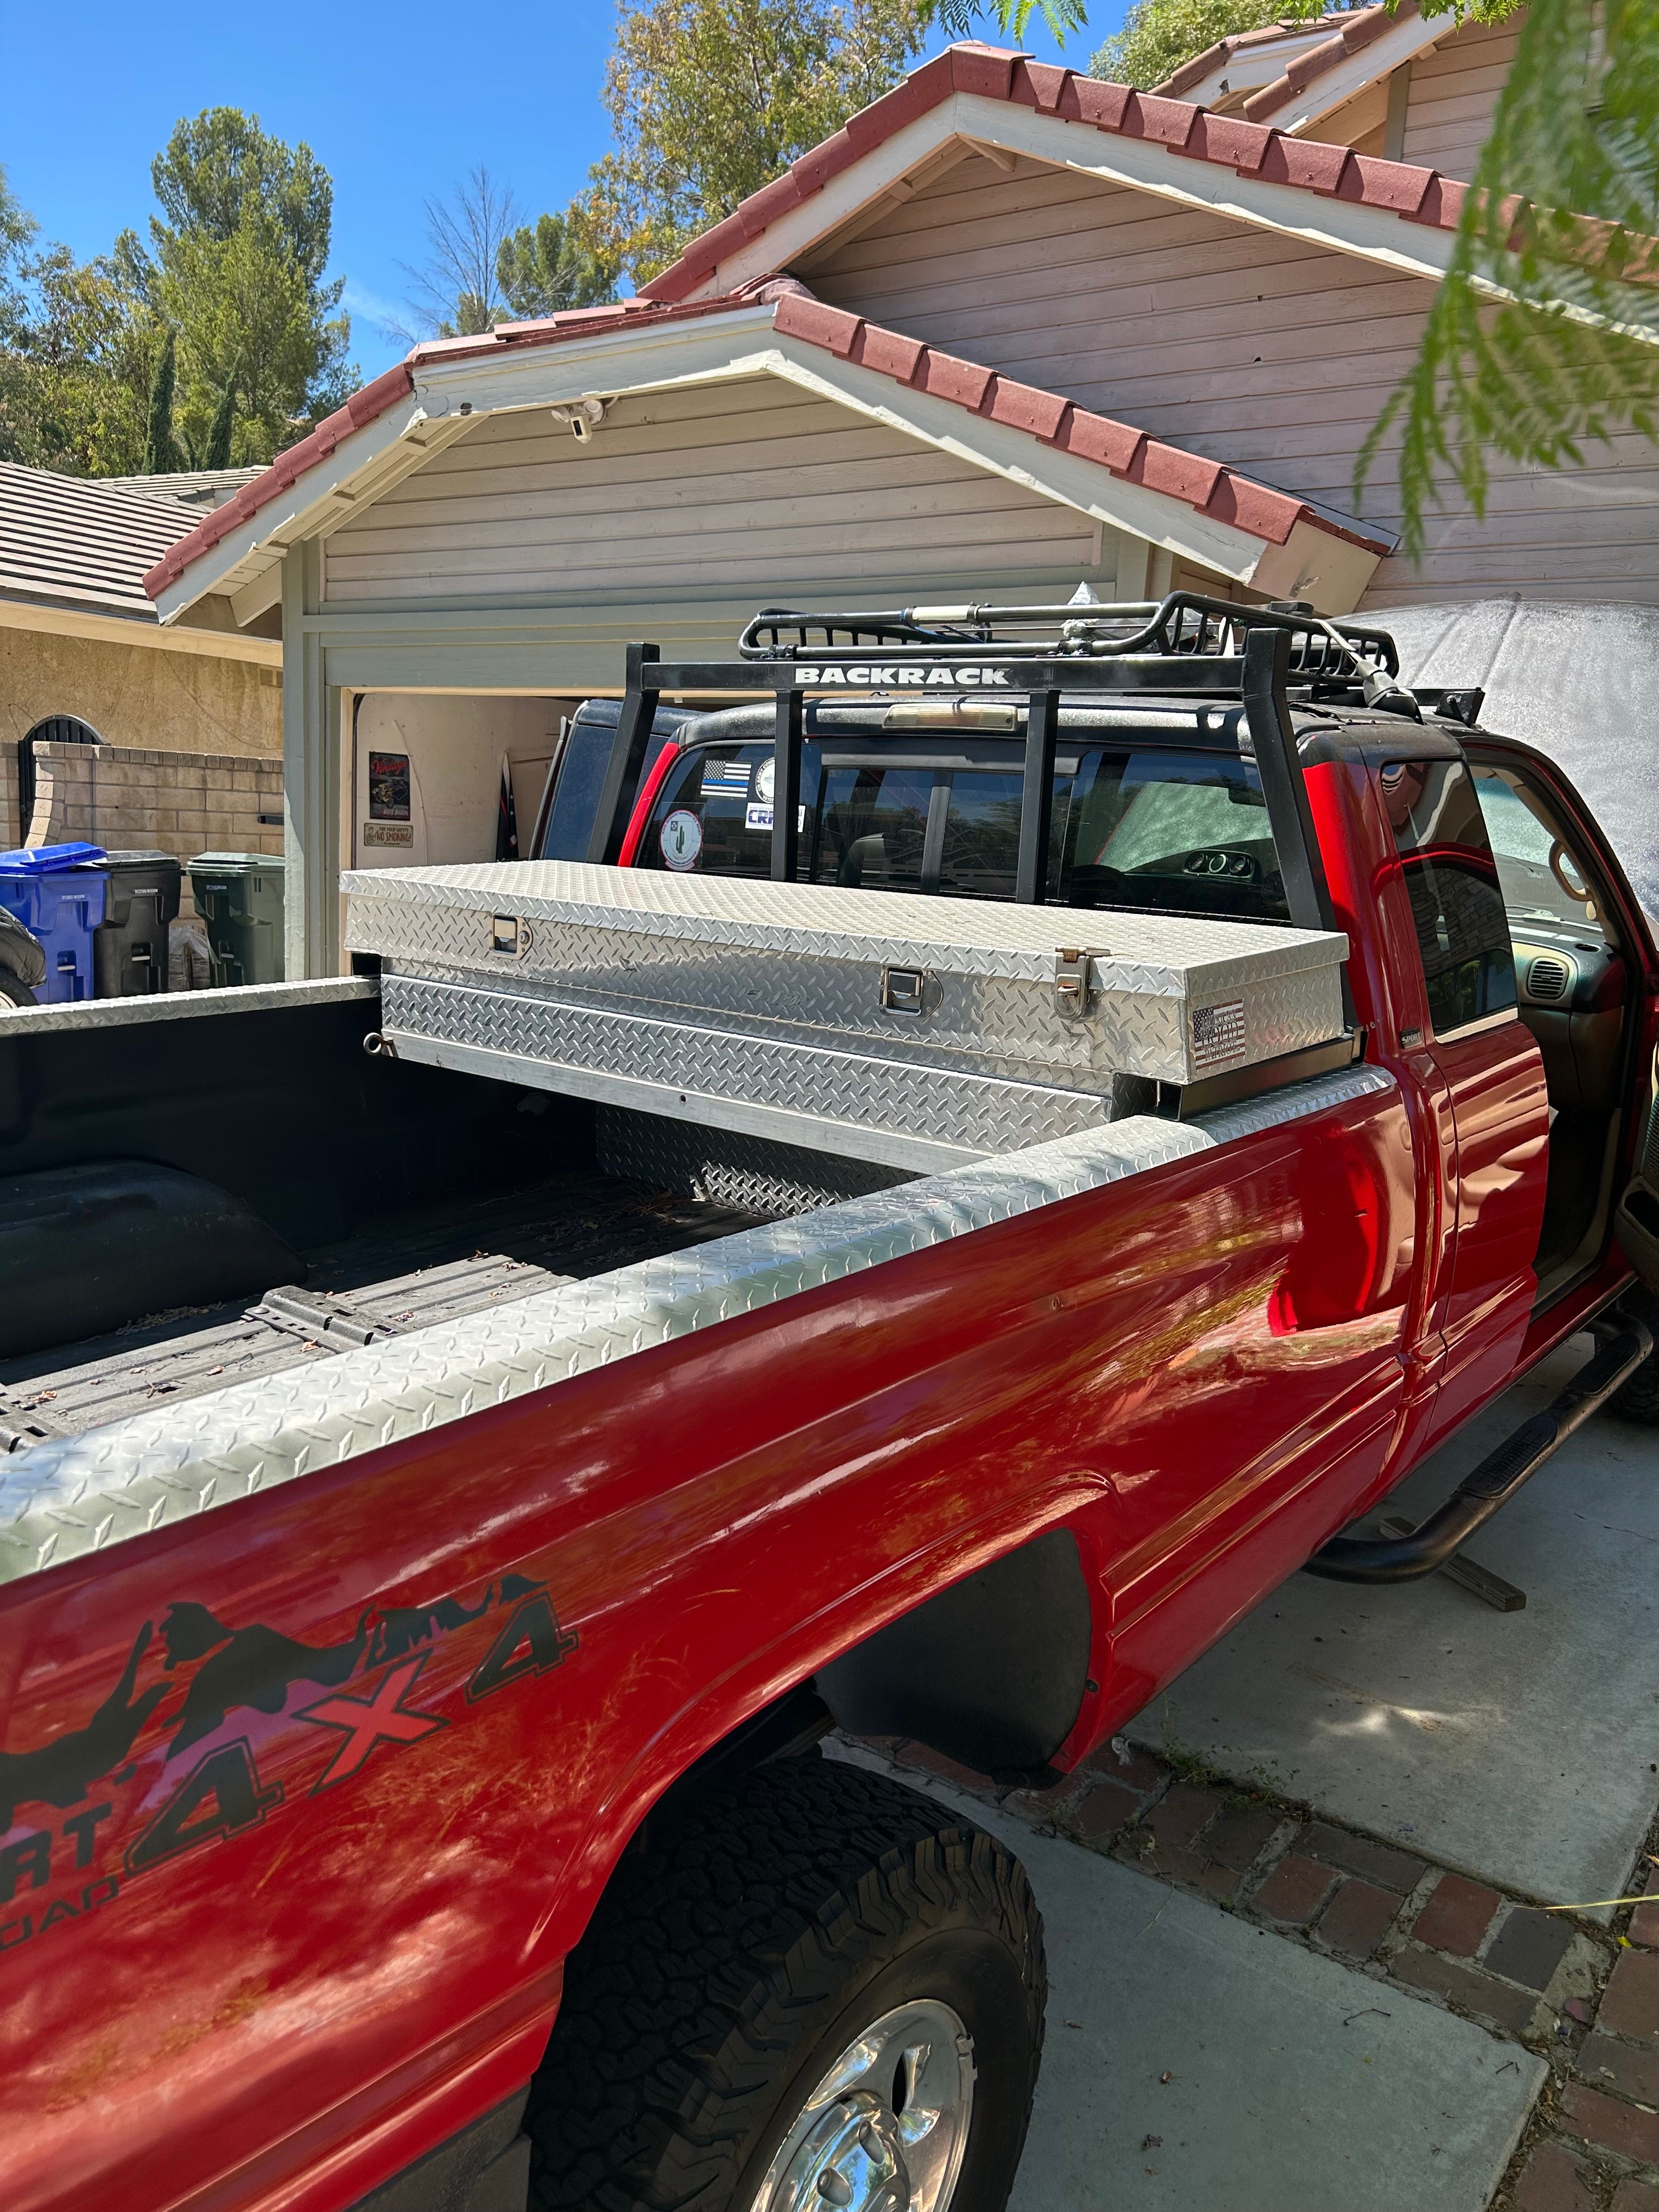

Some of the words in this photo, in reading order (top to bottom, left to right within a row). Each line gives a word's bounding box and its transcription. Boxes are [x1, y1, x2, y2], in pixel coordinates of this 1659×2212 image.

[795, 668, 1011, 685] BACKRACK
[371, 758, 409, 775] Vintage
[377, 832, 385, 841] NO
[386, 832, 411, 842] SMOKING!
[1402, 1032, 1421, 1044] SPORT
[1205, 1041, 1237, 1062] PATRIOT
